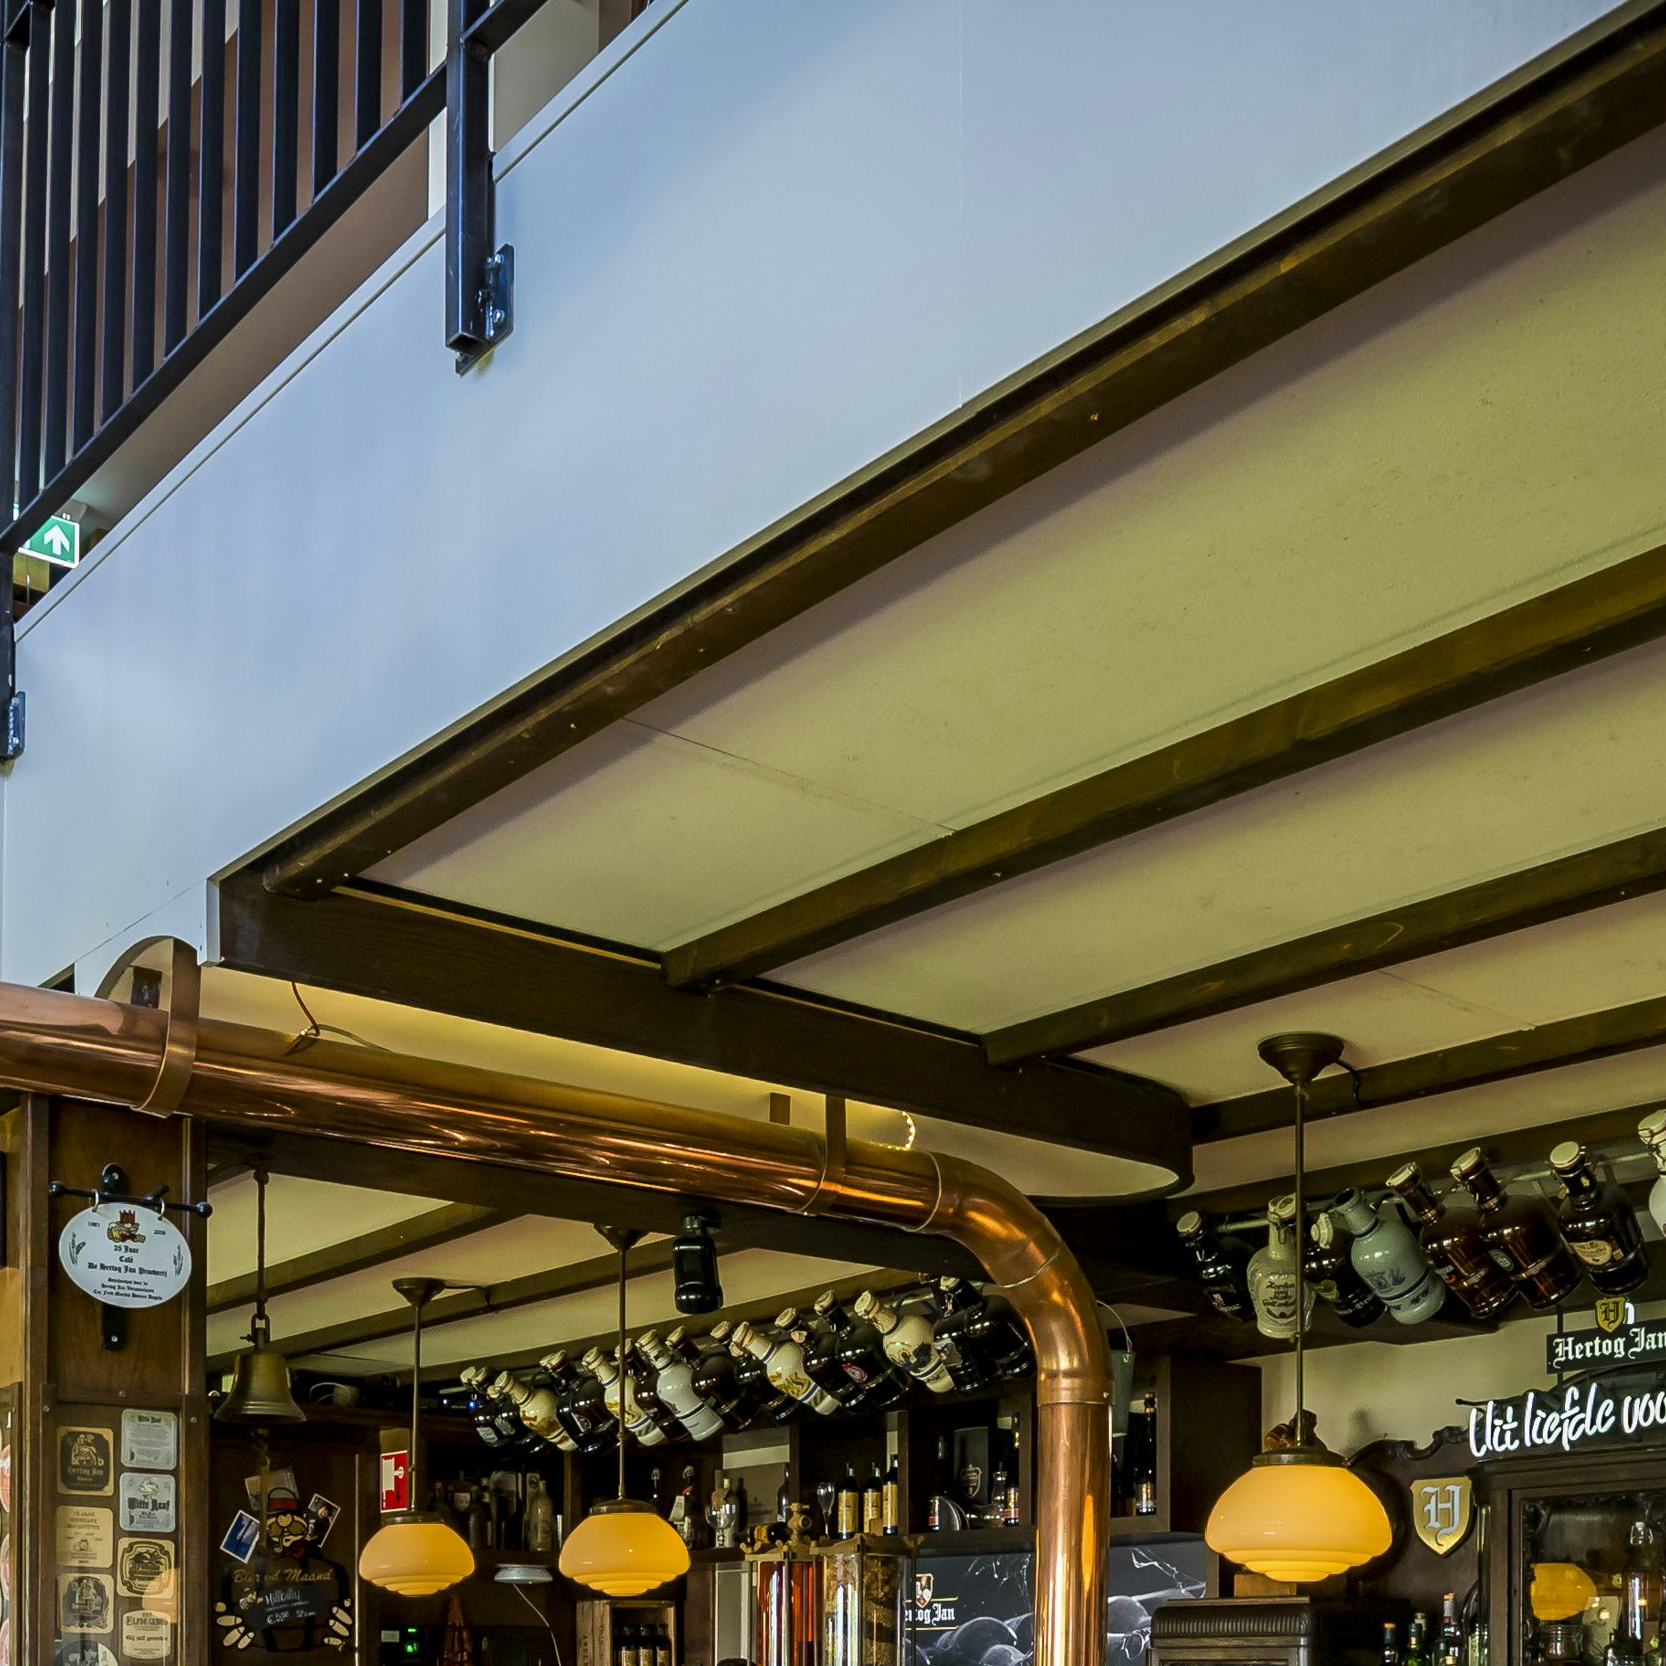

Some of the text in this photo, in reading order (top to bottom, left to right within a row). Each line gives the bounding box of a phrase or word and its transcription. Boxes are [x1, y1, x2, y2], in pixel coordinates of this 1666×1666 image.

[1553, 1338, 1625, 1369] Hertog
[1469, 1401, 1520, 1458] Uit
[1524, 1382, 1616, 1451] liefde
[932, 1603, 955, 1626] Jan
